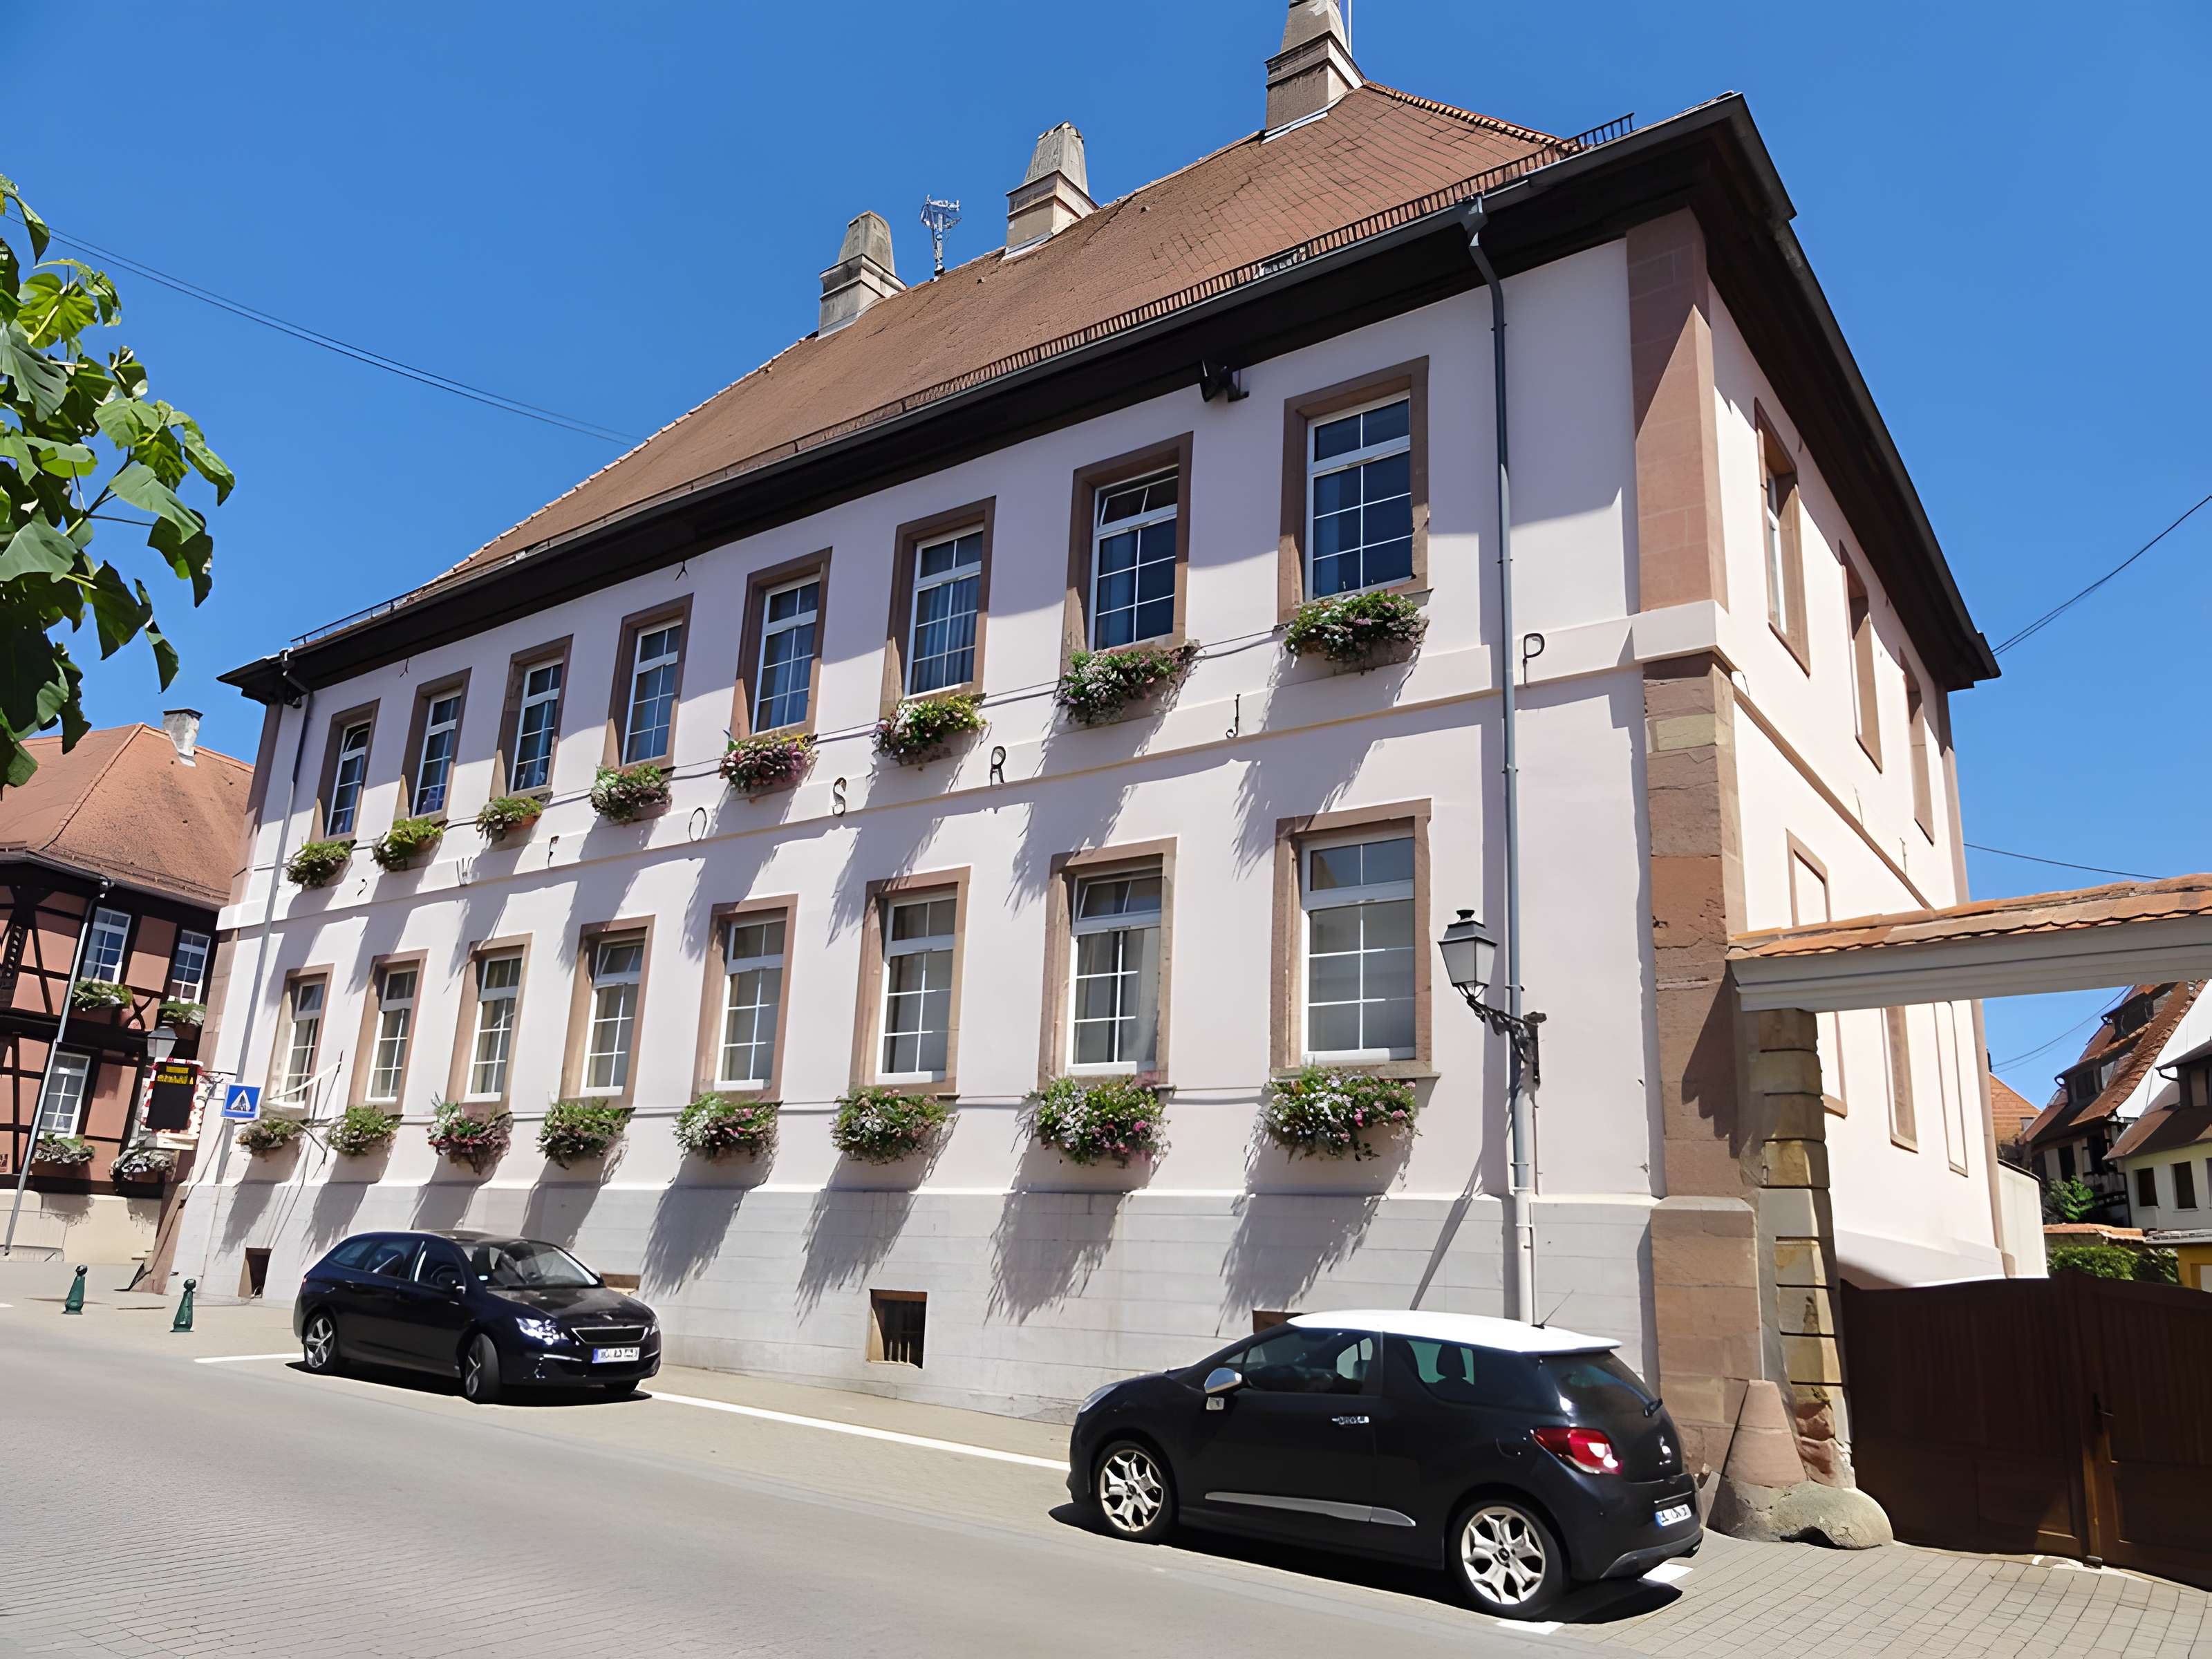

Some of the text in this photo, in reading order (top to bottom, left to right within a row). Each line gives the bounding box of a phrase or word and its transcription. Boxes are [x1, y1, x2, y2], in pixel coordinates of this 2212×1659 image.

[688, 807, 708, 841] O
[832, 777, 847, 817] S
[990, 746, 1006, 786] R
[1522, 632, 1545, 687] P
